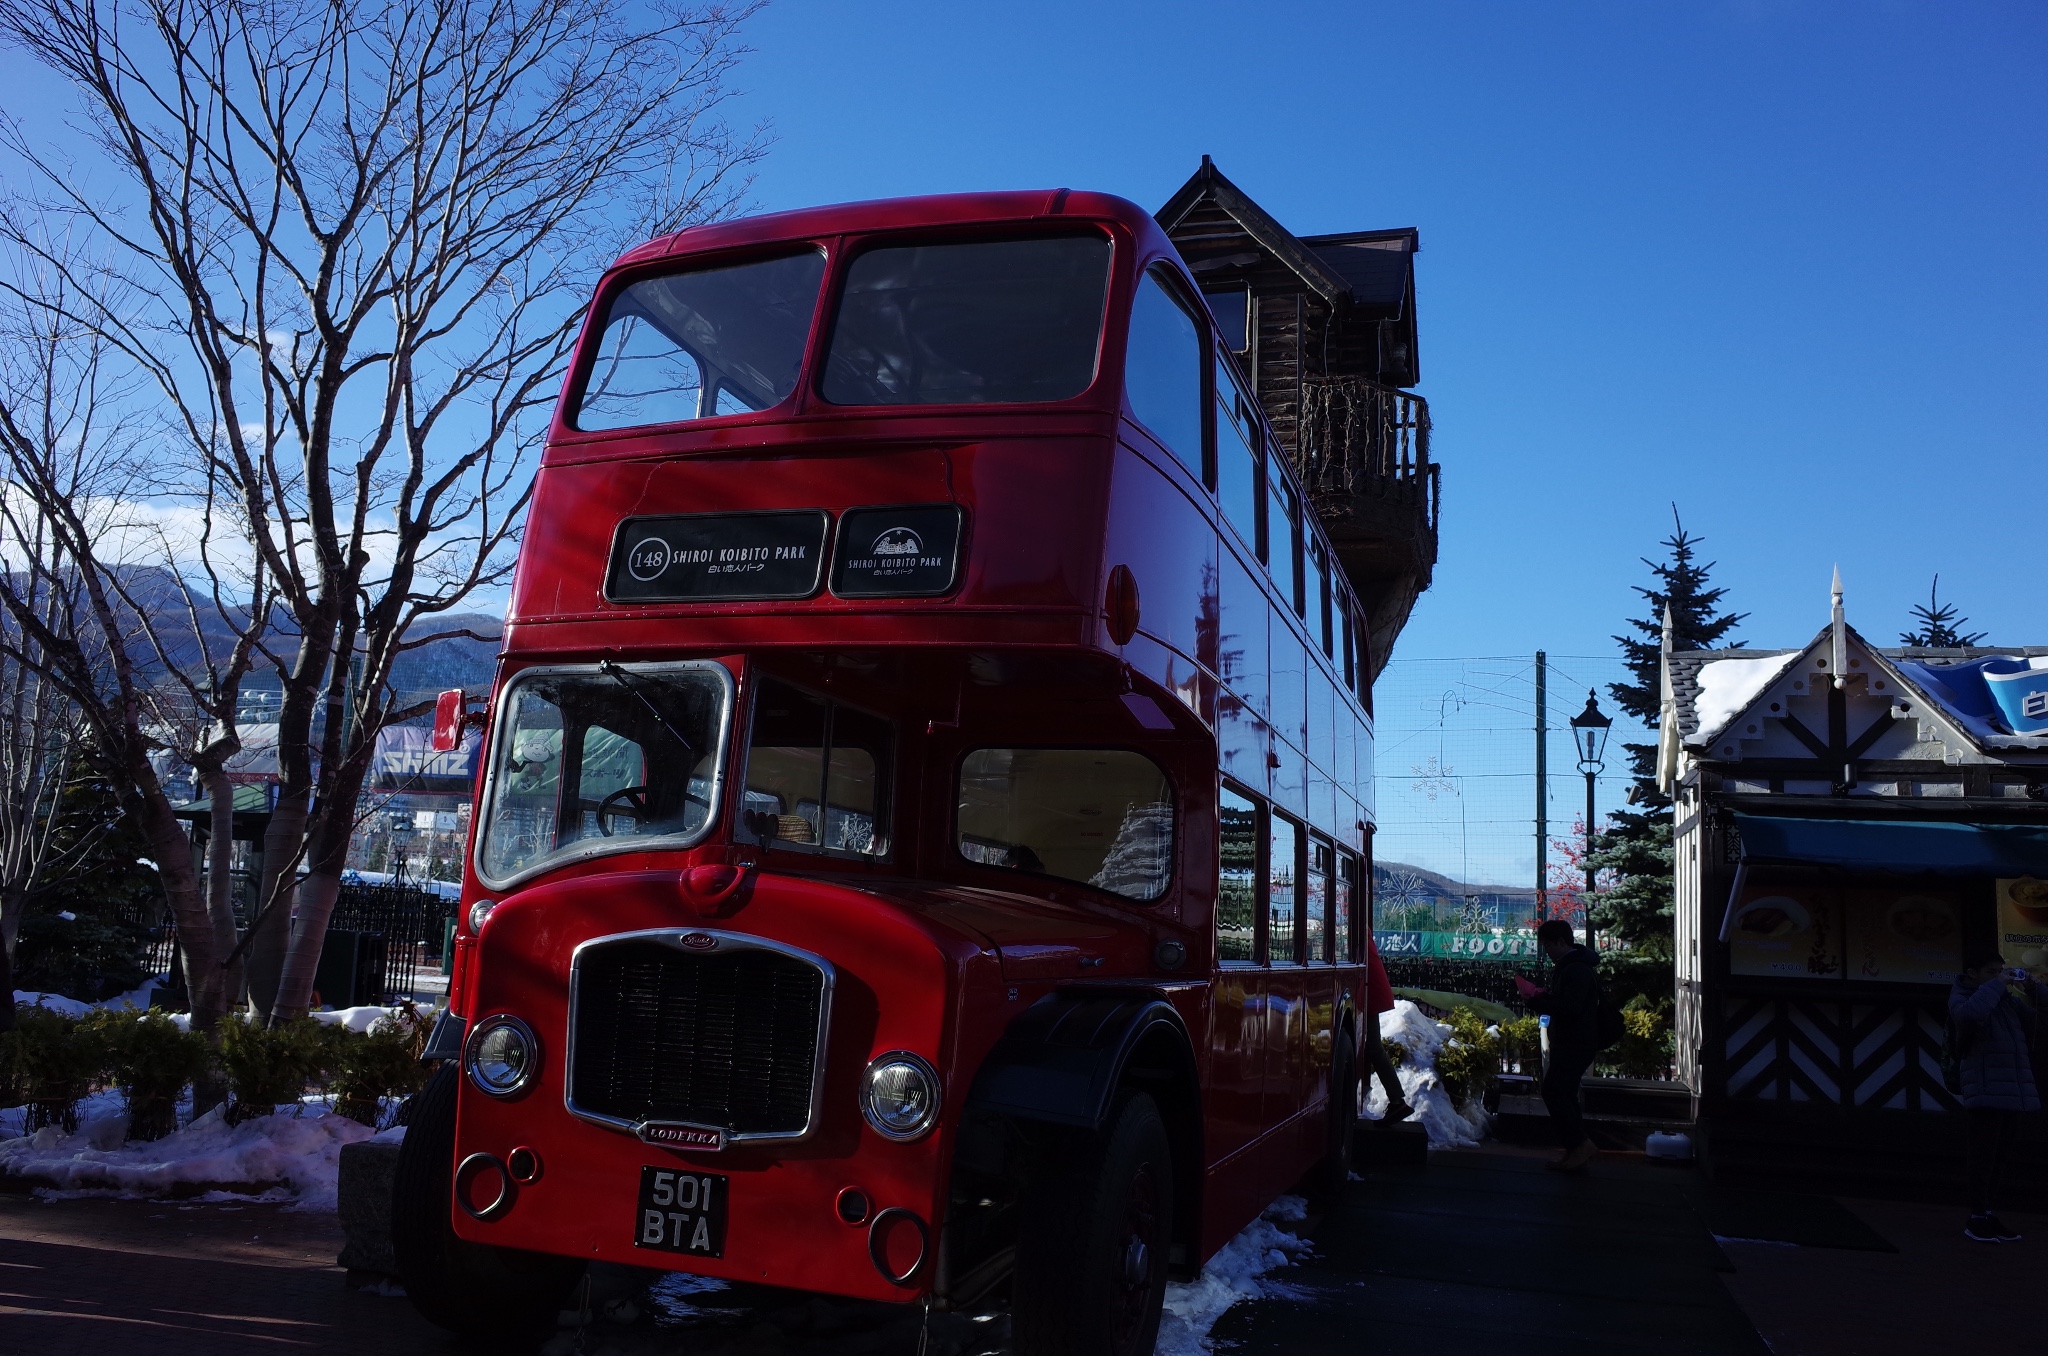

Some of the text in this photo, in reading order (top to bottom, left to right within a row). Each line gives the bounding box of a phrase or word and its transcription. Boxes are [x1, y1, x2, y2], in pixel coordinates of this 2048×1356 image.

[634, 545, 806, 568] 148 SHIROI KOIBITO PARK
[848, 556, 942, 569] SHIROI KOIBITO PARK
[707, 563, 765, 574] 白い恋人パーク
[650, 1127, 719, 1145] LODEKKA
[652, 1170, 712, 1212] 501
[642, 1208, 710, 1251] BTA
